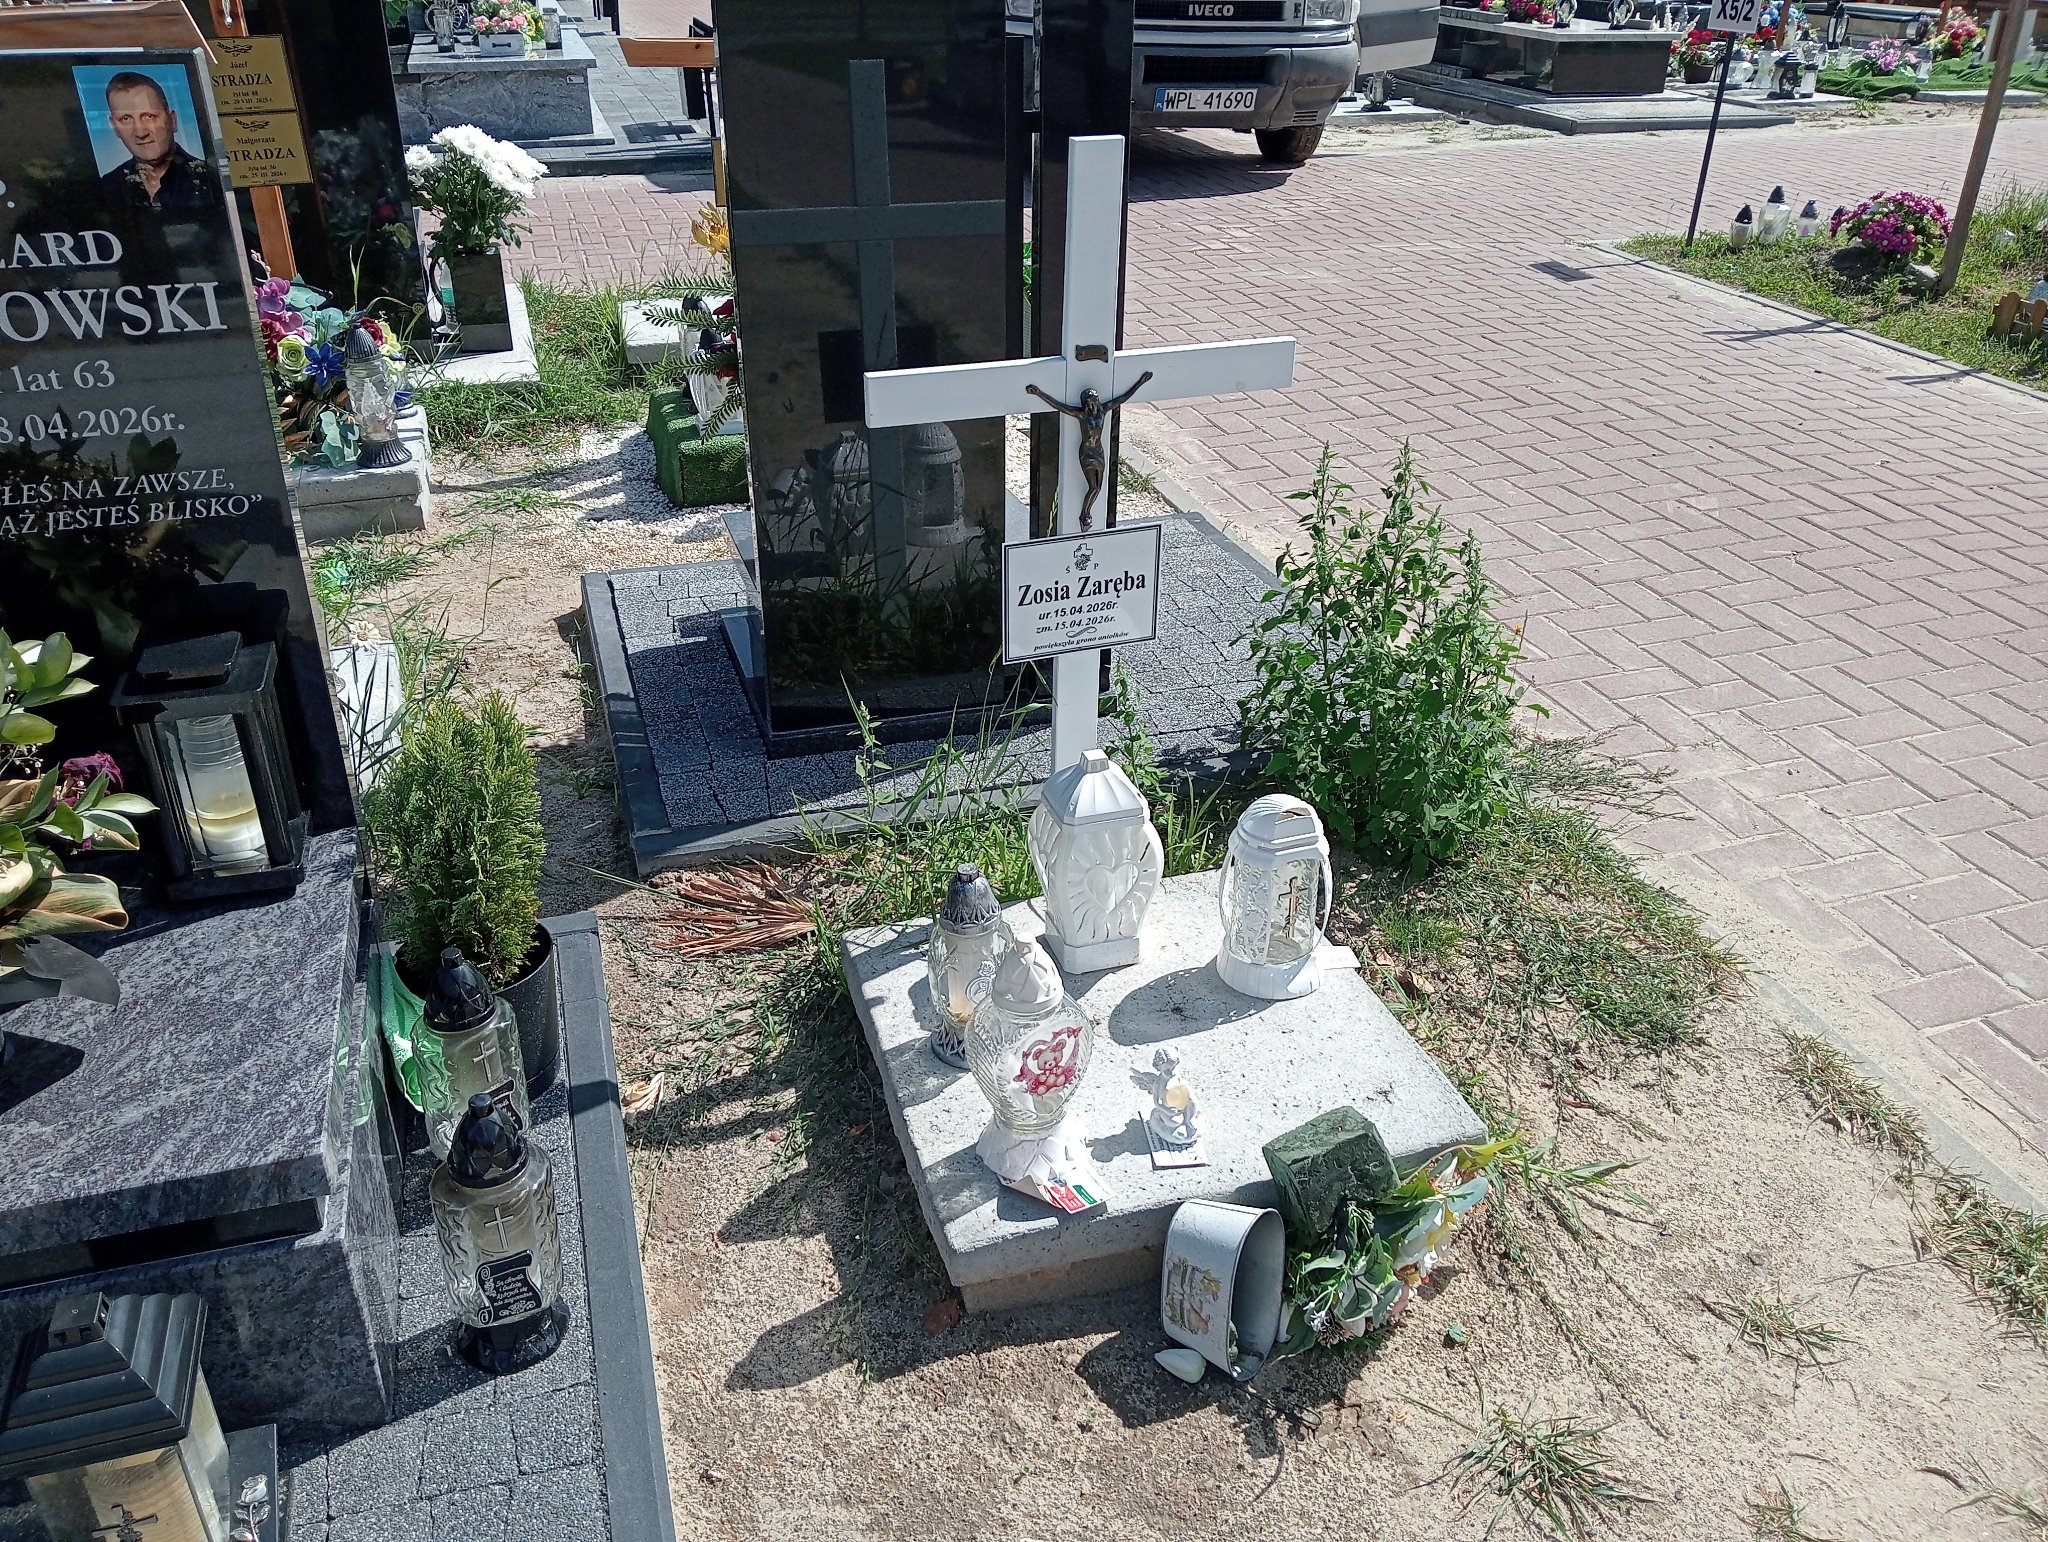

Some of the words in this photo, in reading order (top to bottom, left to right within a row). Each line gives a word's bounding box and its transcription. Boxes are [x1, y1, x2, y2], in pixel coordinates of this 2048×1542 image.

[1188, 3, 1234, 17] IVECO
[1716, 0, 1755, 23] X5/2
[211, 73, 273, 87] STRADZA
[1165, 92, 1196, 110] WPL
[1203, 91, 1254, 110] 41690
[0, 230, 123, 269] ARD
[0, 282, 228, 342] OWSKI
[10, 365, 64, 393] lat
[73, 359, 115, 389] 63
[0, 475, 52, 506] ŁEŚ
[62, 478, 105, 501] NA
[113, 468, 235, 497] ZAWSZE,
[44, 498, 140, 537] JESTEŚ
[1018, 580, 1070, 607] Zosia
[1077, 570, 1146, 599] Zaręba
